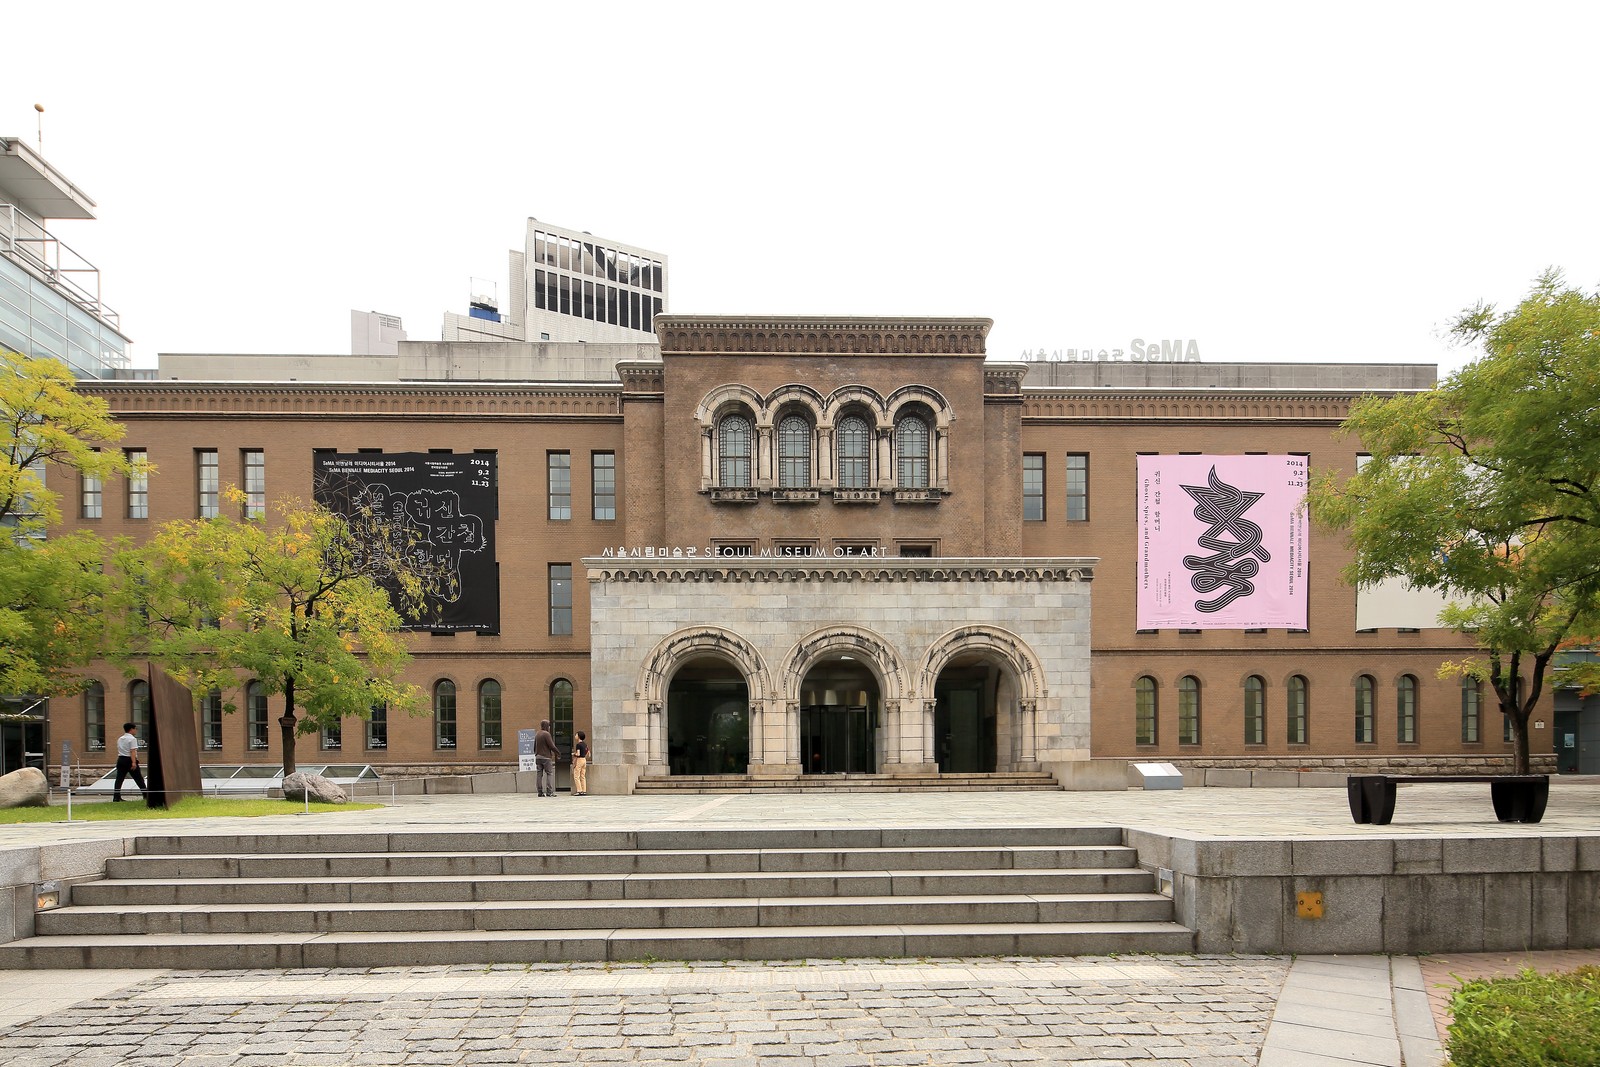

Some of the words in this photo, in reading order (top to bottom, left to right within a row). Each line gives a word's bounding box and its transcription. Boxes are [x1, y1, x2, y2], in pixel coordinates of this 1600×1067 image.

[1020, 348, 1124, 362] 서울시립미술관
[1130, 338, 1201, 362] SeMA
[470, 459, 489, 467] 2014
[602, 546, 697, 558] 서울시립미술관
[704, 546, 753, 558] SEOUL
[760, 546, 827, 558] MUSEUM
[833, 546, 853, 558] OF
[859, 546, 887, 558] ART
